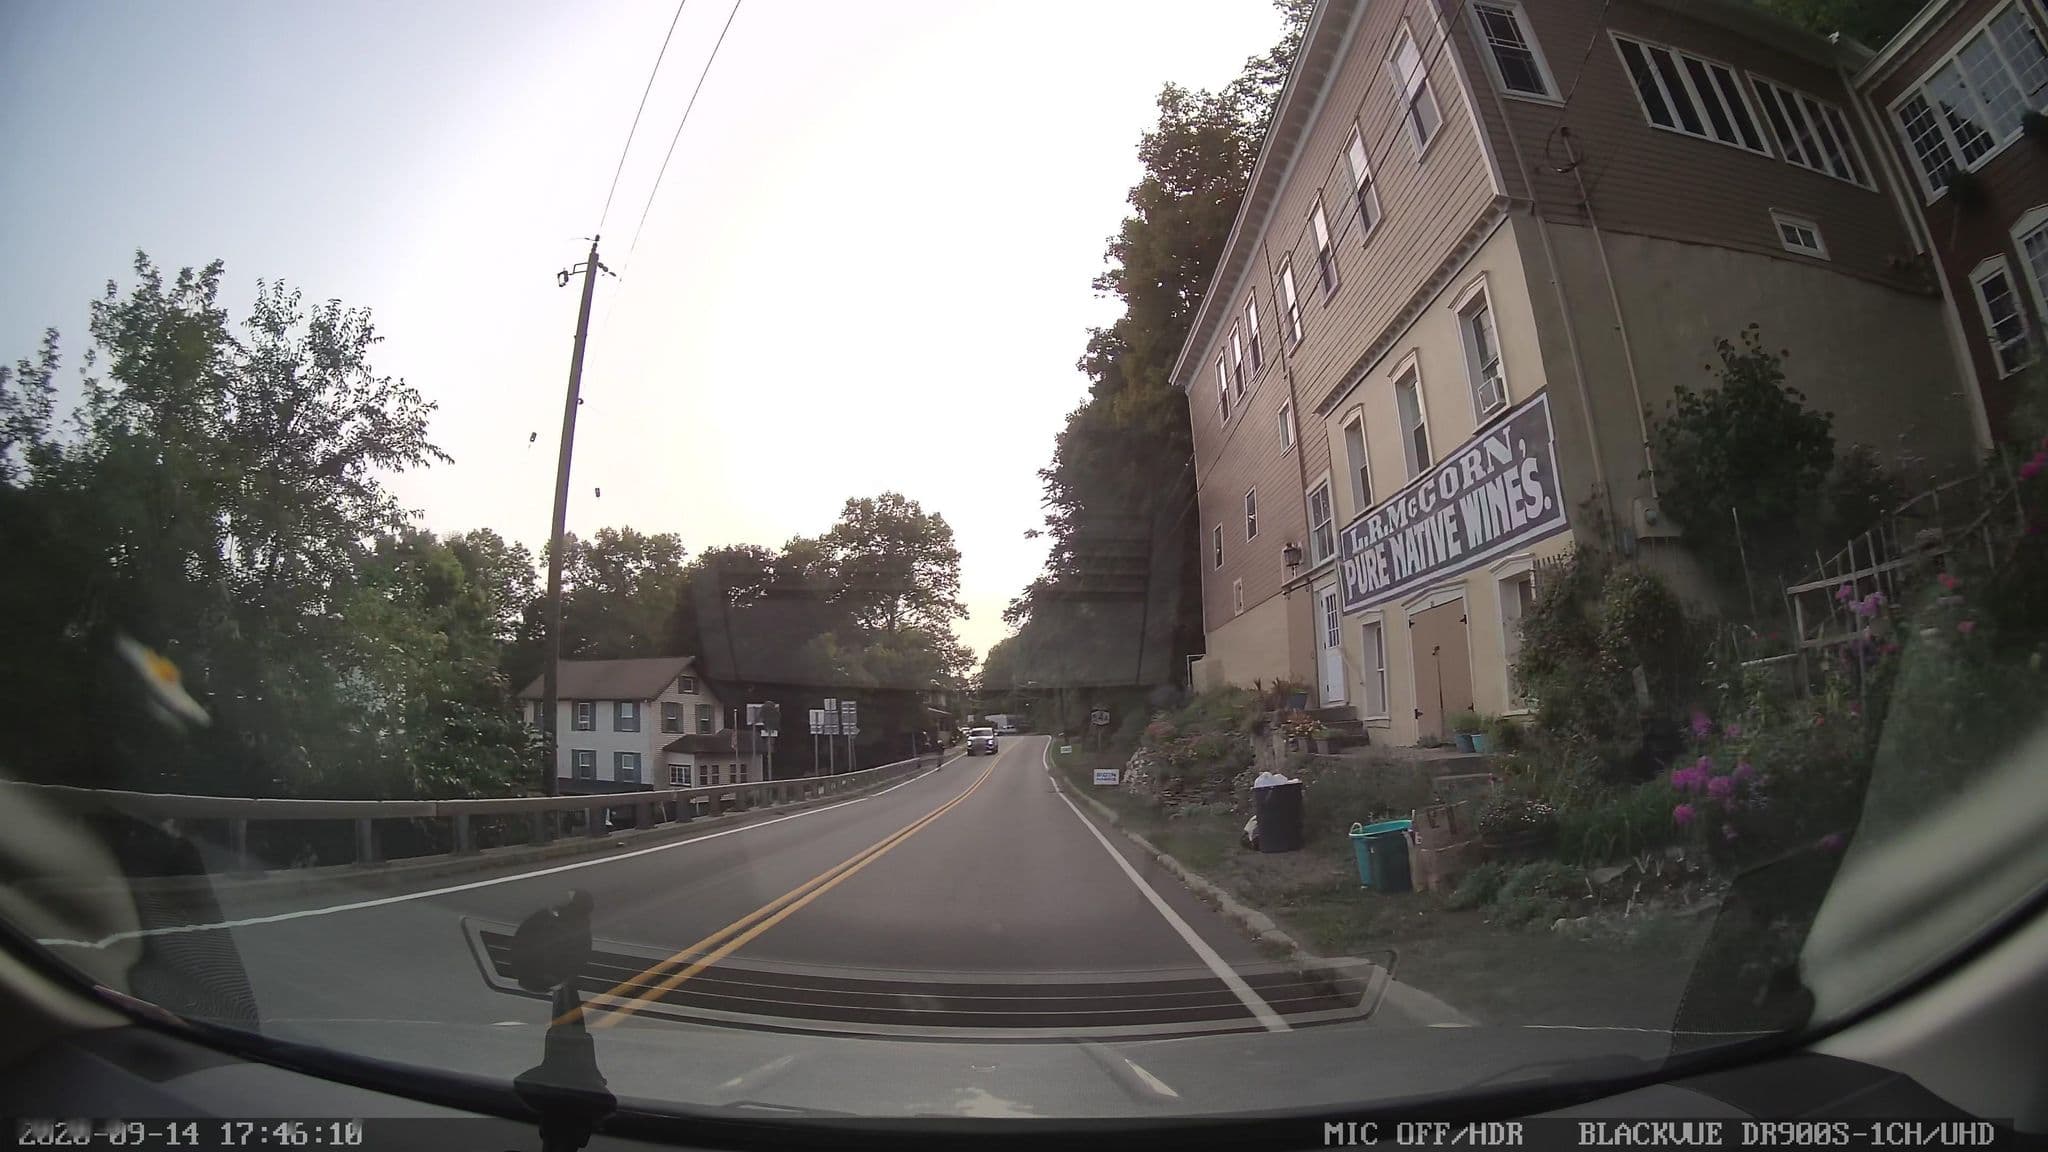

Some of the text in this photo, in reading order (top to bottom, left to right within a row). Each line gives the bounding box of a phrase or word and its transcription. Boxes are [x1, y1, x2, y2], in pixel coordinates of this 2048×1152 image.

[1343, 457, 1552, 600] PURE NATIVE WINES.
